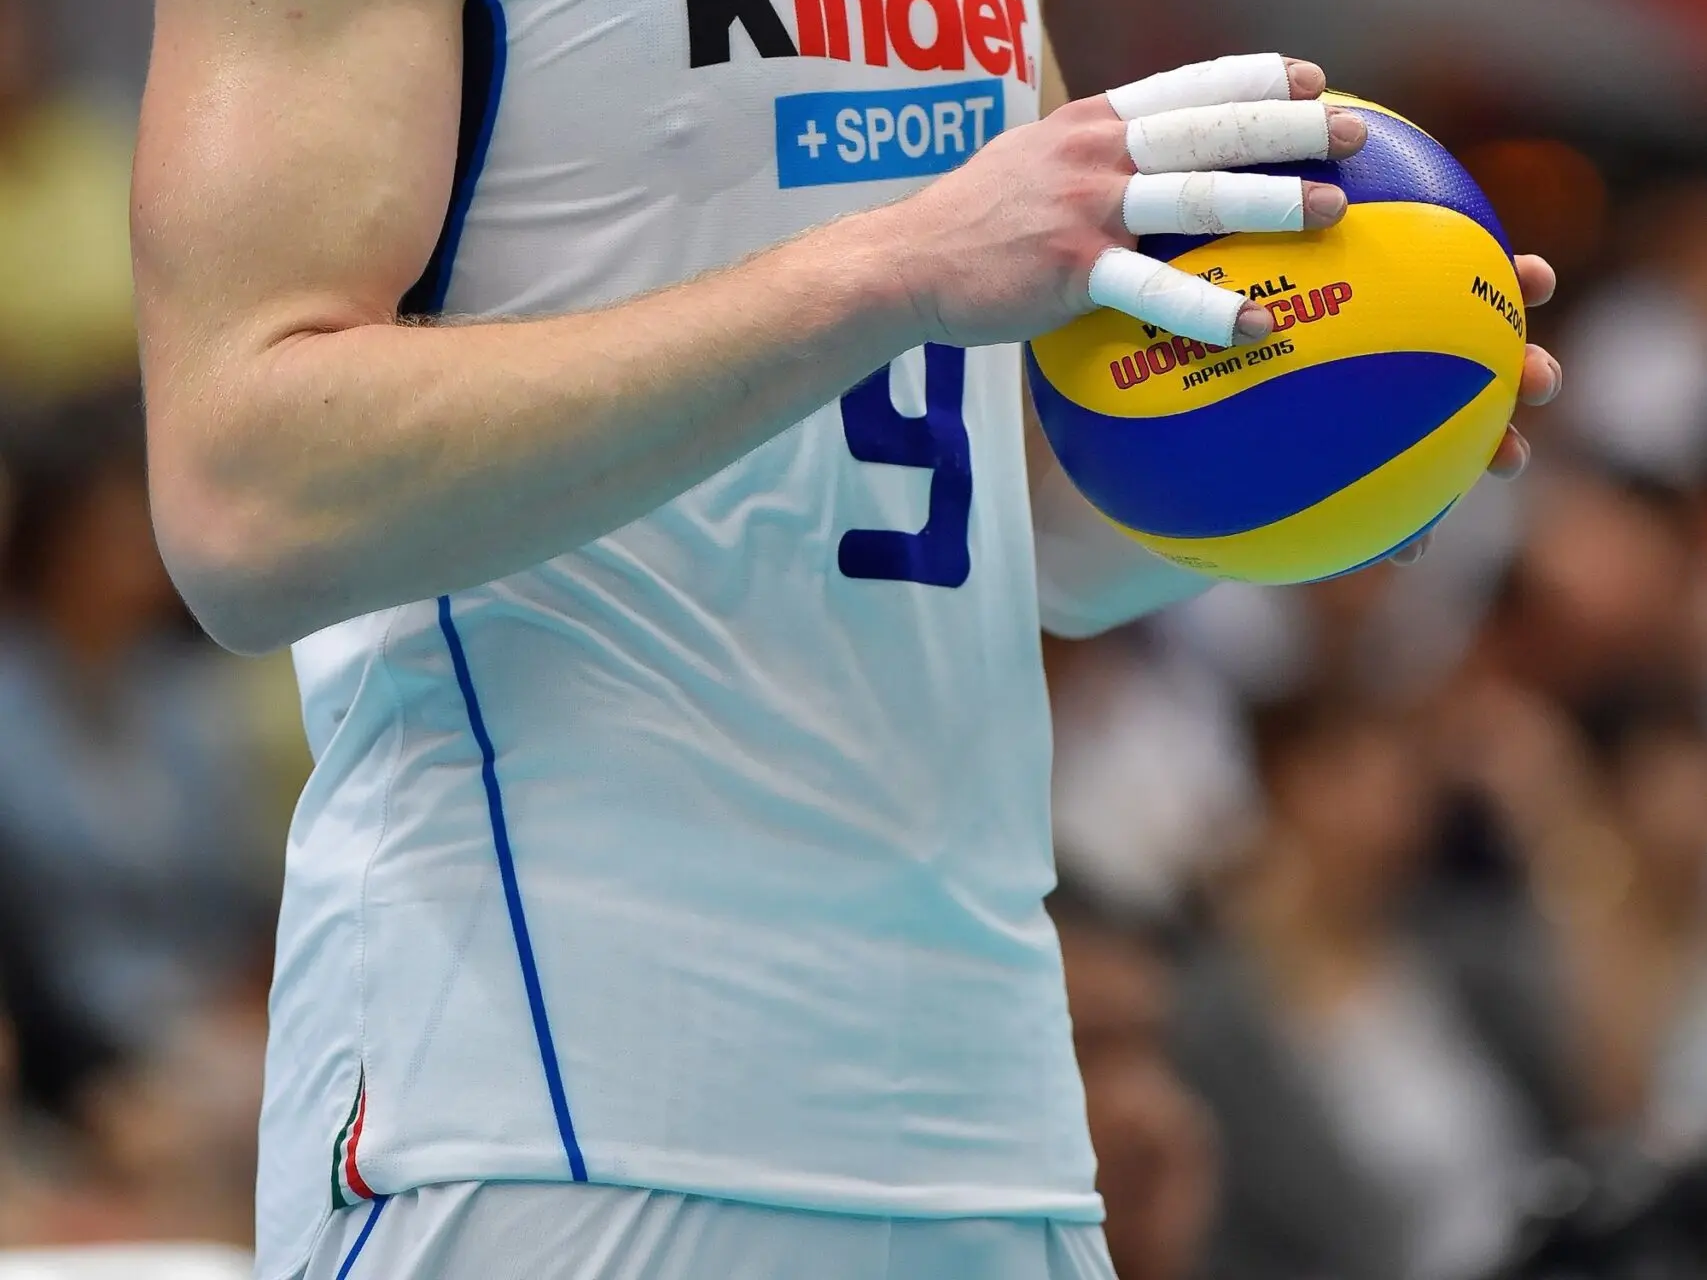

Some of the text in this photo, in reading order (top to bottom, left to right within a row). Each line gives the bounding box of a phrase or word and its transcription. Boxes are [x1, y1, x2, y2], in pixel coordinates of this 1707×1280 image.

[835, 95, 995, 164] SPORT
[1110, 334, 1237, 390] WOR
[1265, 281, 1353, 333] CUP
[1471, 275, 1523, 339] MVA200
[1182, 338, 1295, 391] JAPAN 2015
